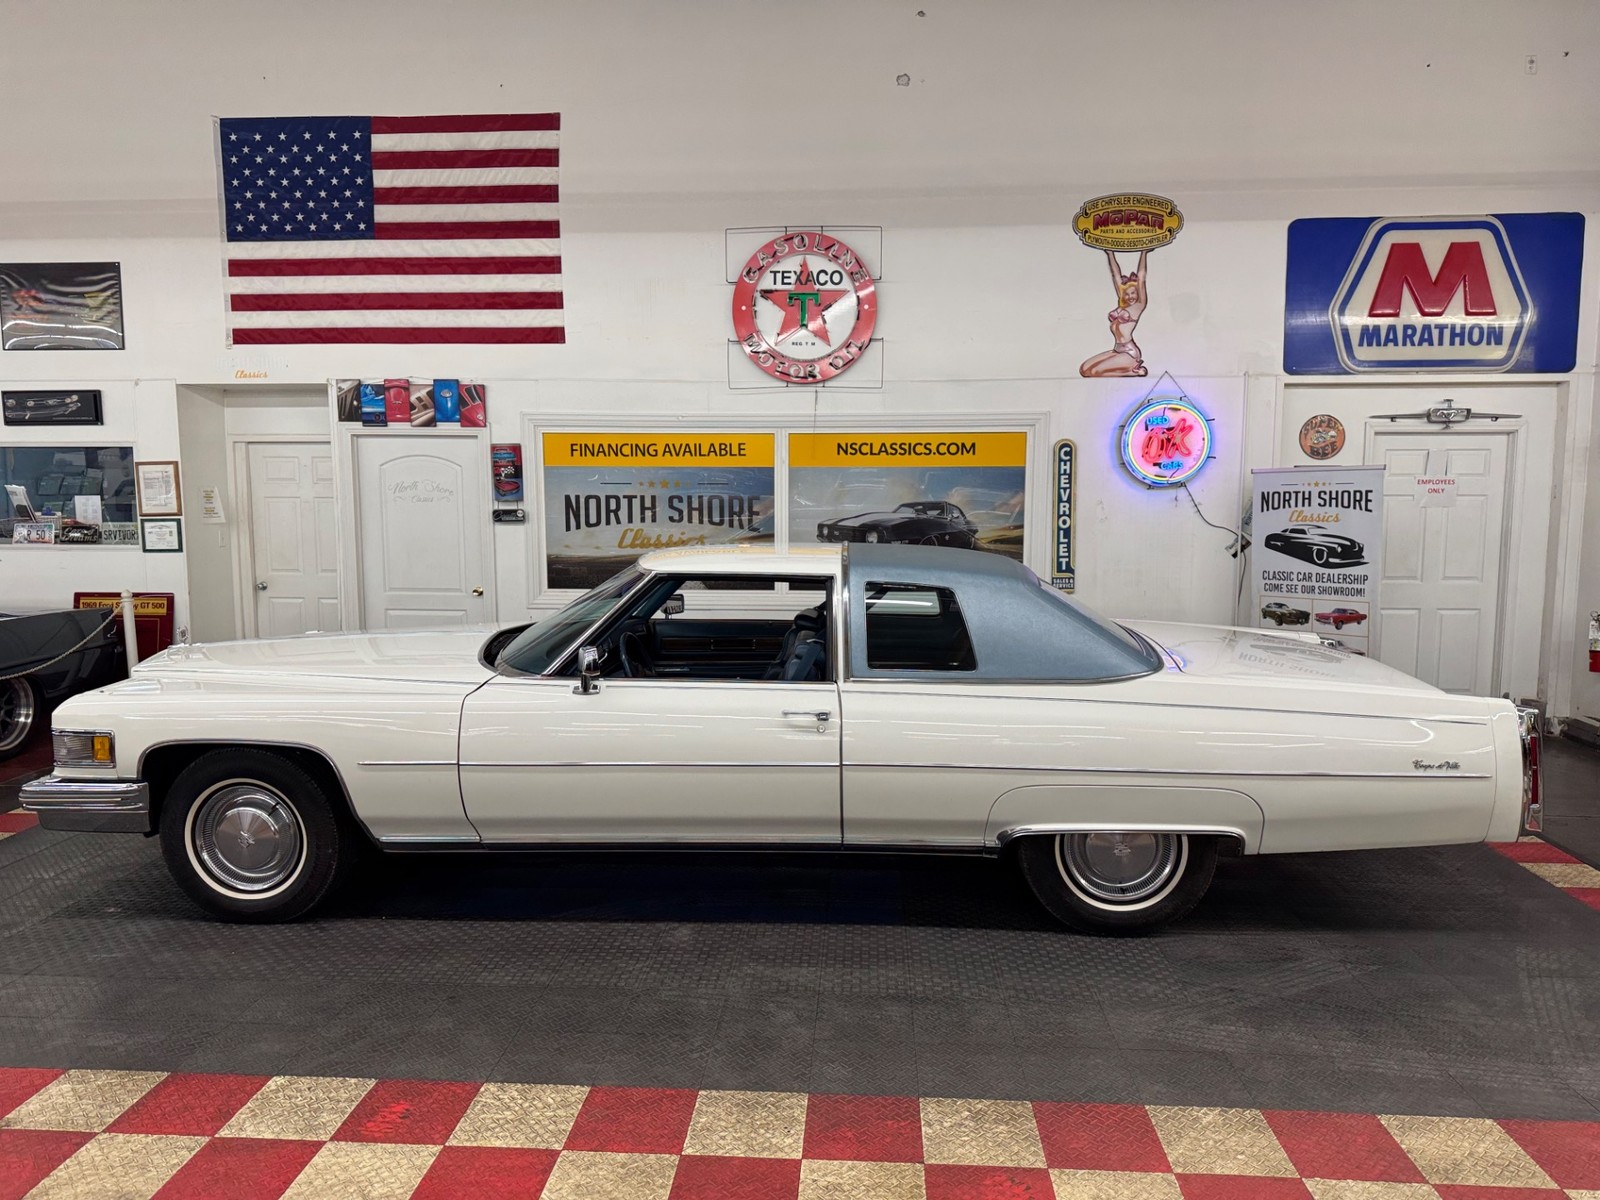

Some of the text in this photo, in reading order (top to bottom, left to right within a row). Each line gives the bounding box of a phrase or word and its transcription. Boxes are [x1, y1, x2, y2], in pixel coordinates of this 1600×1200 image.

[1088, 197, 1169, 211] USE CHRYSLER ENGINEERED
[1093, 209, 1165, 231] MOPAR
[743, 233, 869, 286] GASOLINE
[769, 269, 844, 286] TEXACO
[787, 292, 821, 329] T
[1358, 323, 1503, 348] MARATHON
[743, 333, 866, 380] MOTOR OIL
[234, 369, 269, 379] Classics
[1146, 415, 1169, 425] USED
[569, 442, 747, 458] FINANCING AVAILABLE
[836, 441, 976, 457] NSCLASSICS.COM
[1310, 441, 1338, 458] BEE
[1160, 461, 1184, 470] CARS
[1417, 478, 1456, 486] EMPLOYEES
[1427, 487, 1446, 495] ONLY
[1058, 447, 1072, 571] CHEVROLET
[1260, 489, 1374, 513] NORTH SHORE
[564, 494, 761, 533] NORTH SHORE
[1288, 509, 1342, 524] Classics
[1262, 570, 1369, 586] CLASSIC CAR DEALERSHIP
[1263, 582, 1366, 598] COME SEE OUR SHOWROOM!
[82, 601, 97, 609] 1969
[140, 601, 150, 610] GT
[152, 601, 165, 610] 500
